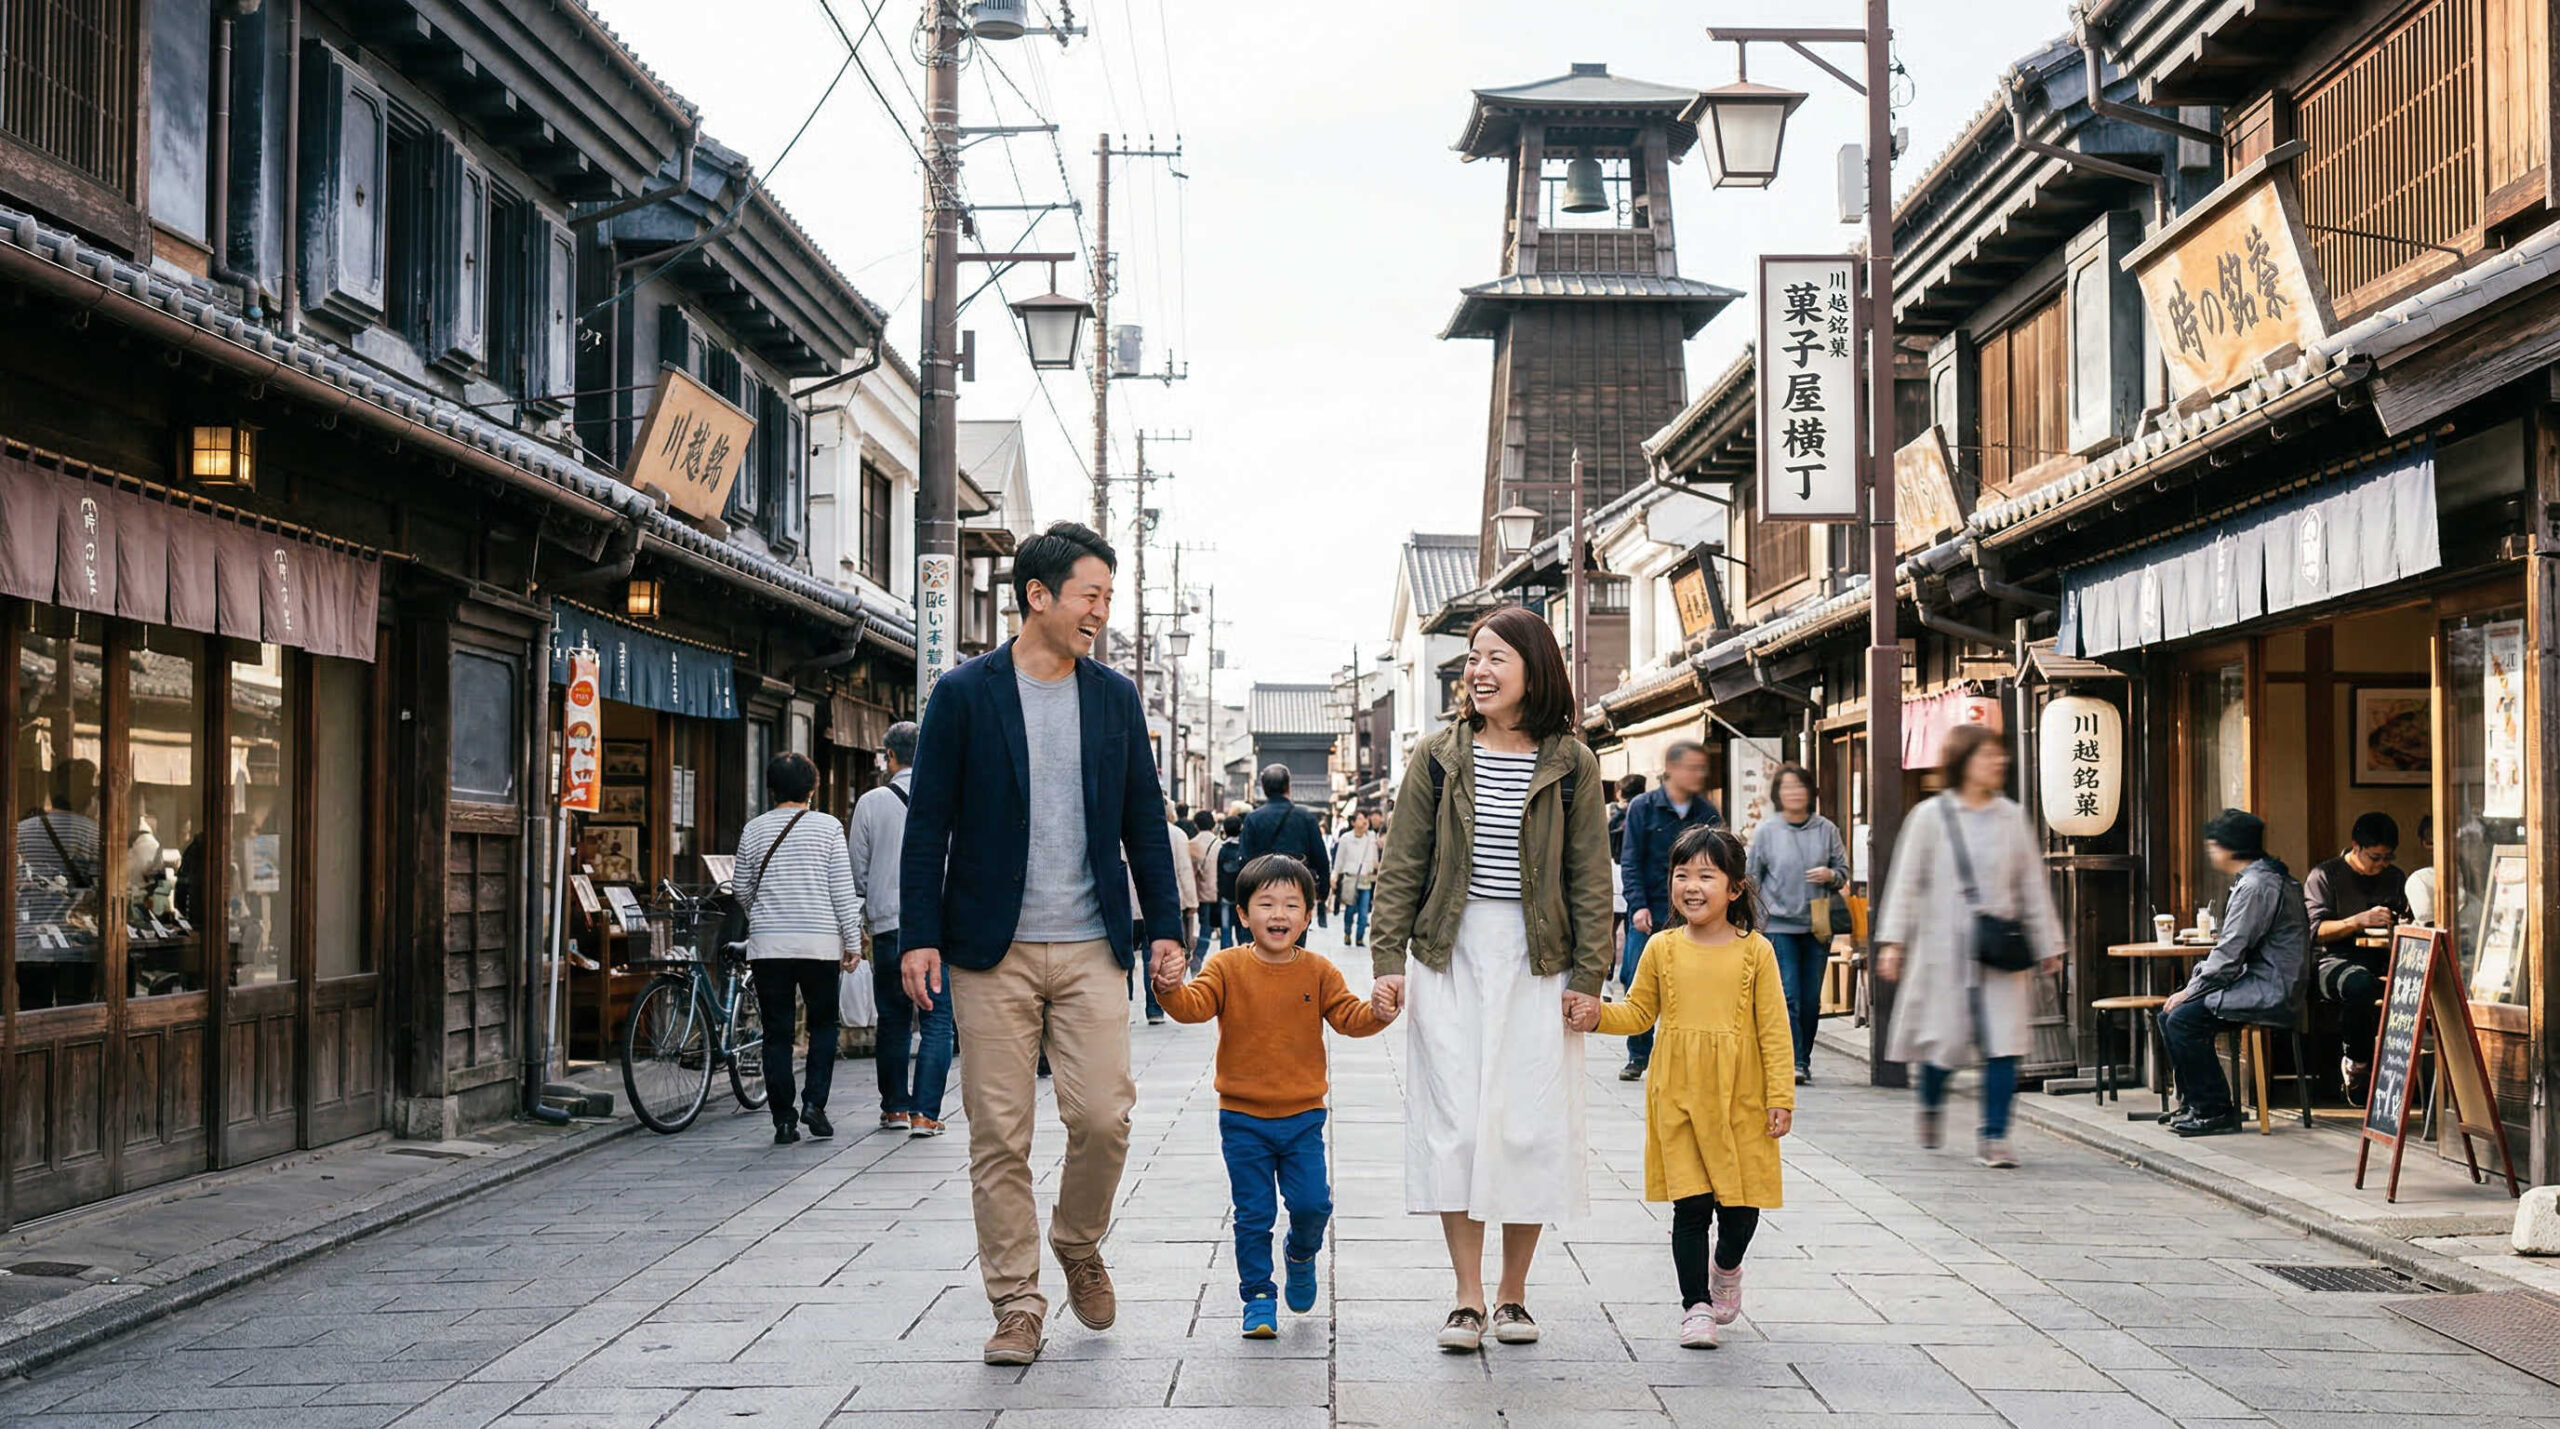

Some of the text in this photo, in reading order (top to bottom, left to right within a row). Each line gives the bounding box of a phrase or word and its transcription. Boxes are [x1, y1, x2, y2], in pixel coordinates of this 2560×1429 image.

[1827, 270, 1849, 358] 川越銘菓
[1781, 281, 1827, 500] 菓子屋横丁
[2072, 713, 2100, 817] 川越銘菓
